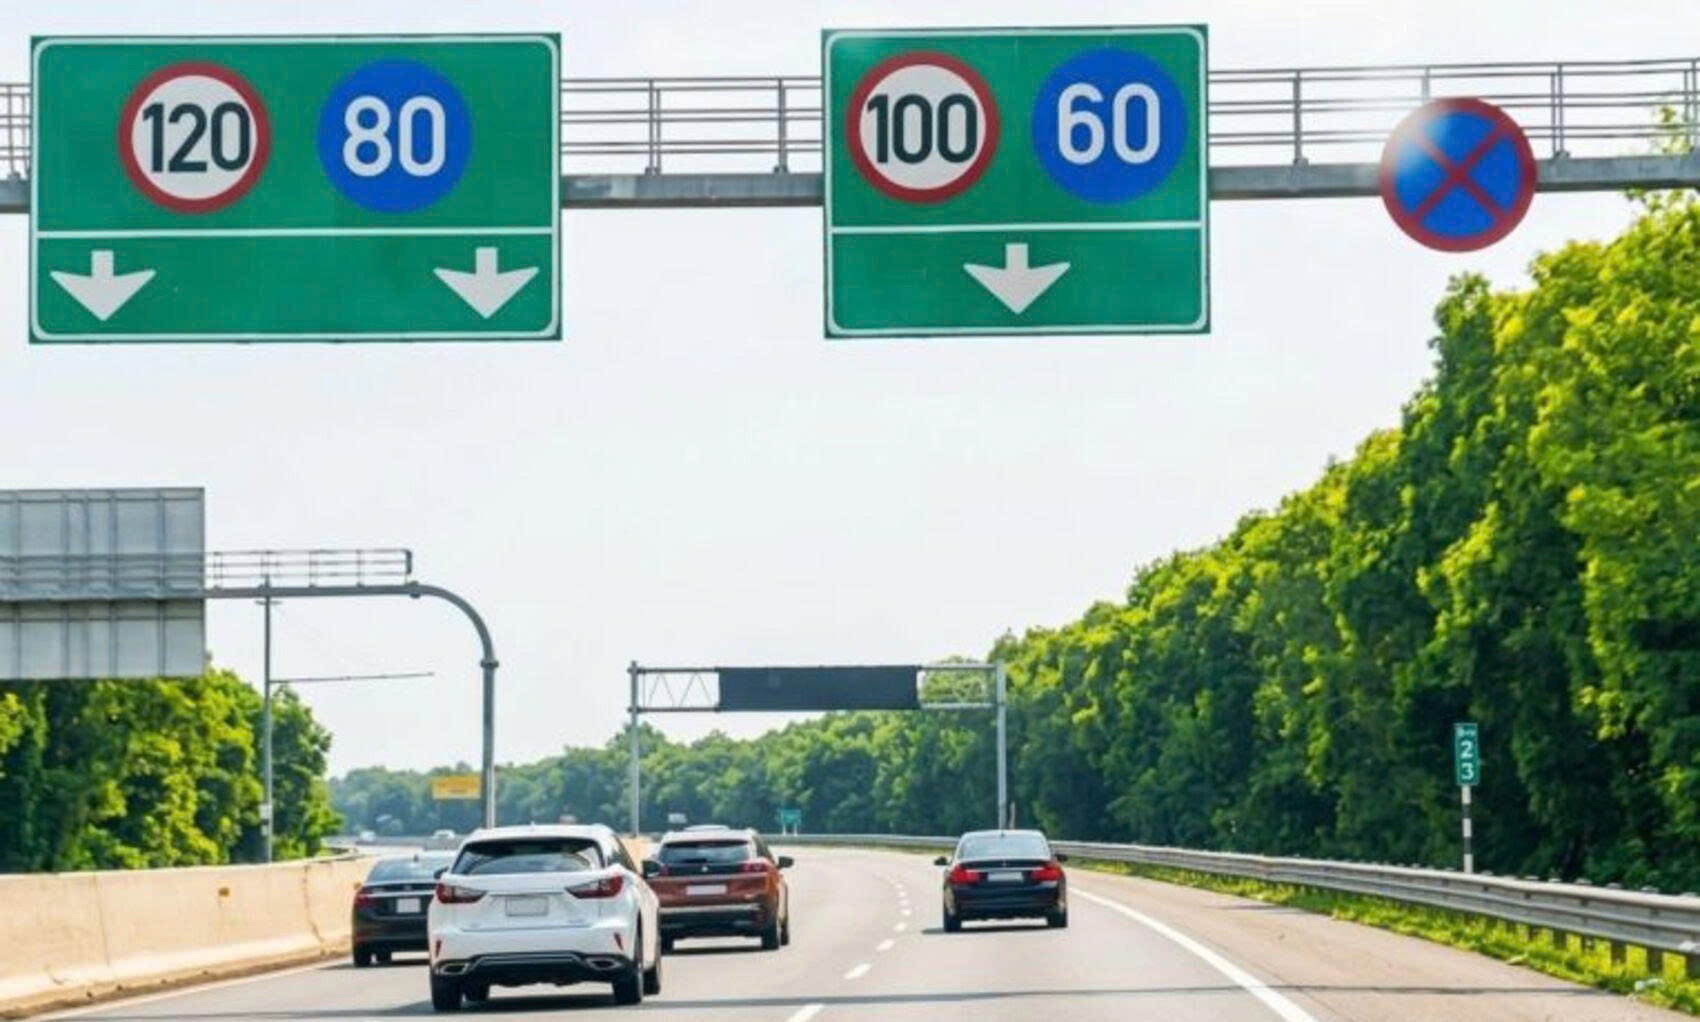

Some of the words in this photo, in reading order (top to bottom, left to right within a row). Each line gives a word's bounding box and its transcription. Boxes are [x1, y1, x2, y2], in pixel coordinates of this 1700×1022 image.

[142, 101, 250, 173] 120
[343, 95, 446, 177] 80
[867, 93, 978, 164] 100
[1057, 82, 1160, 166] 60
